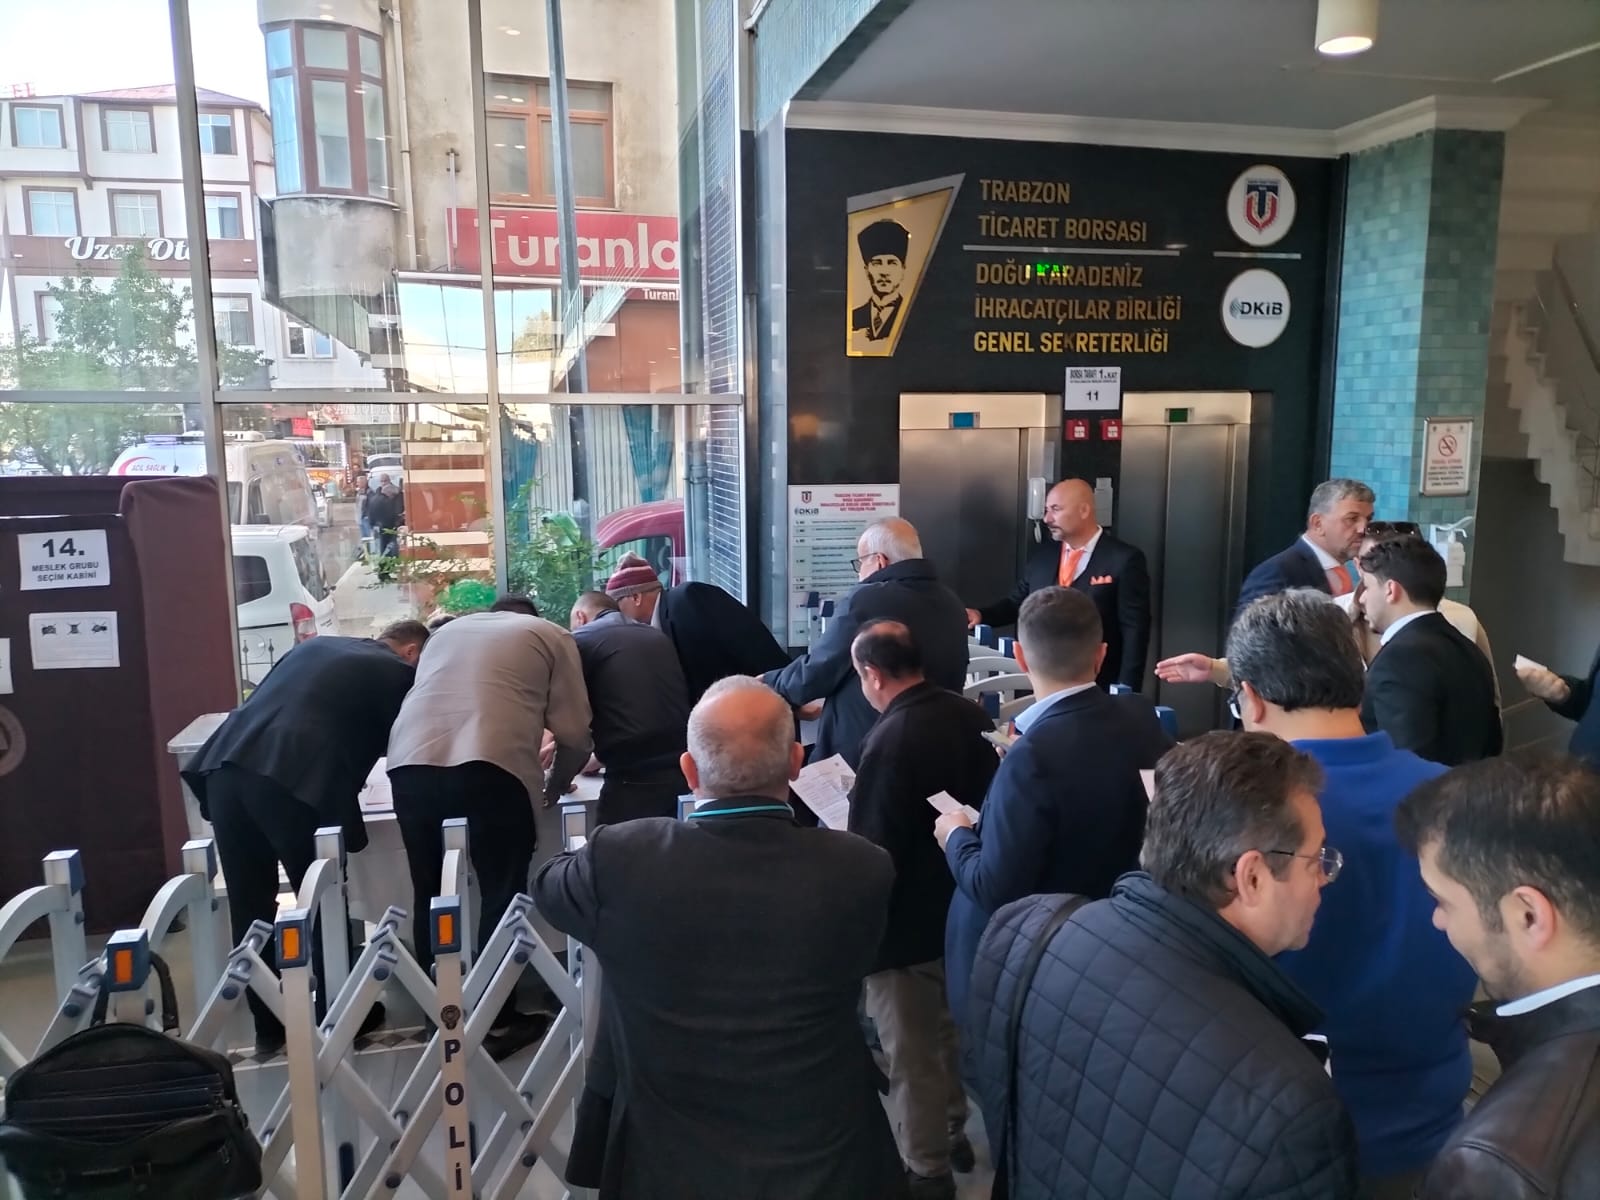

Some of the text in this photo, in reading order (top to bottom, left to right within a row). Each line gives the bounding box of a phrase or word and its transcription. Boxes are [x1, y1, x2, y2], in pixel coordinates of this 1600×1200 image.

[979, 179, 1071, 204] TRABZON
[978, 211, 1147, 242] TİCARET BORSASI
[975, 259, 1143, 287] DOĞU KARADENİZ
[974, 293, 1182, 325] İHRACATÇILAR BİRLİĞİ
[974, 328, 1169, 353] GENEL SEKRETERLİĞİ
[1086, 391, 1099, 401] 11
[42, 537, 85, 558] 14.
[31, 561, 99, 572] MESLEK GRUBU
[37, 571, 97, 583] SEÇİM KABİNİ
